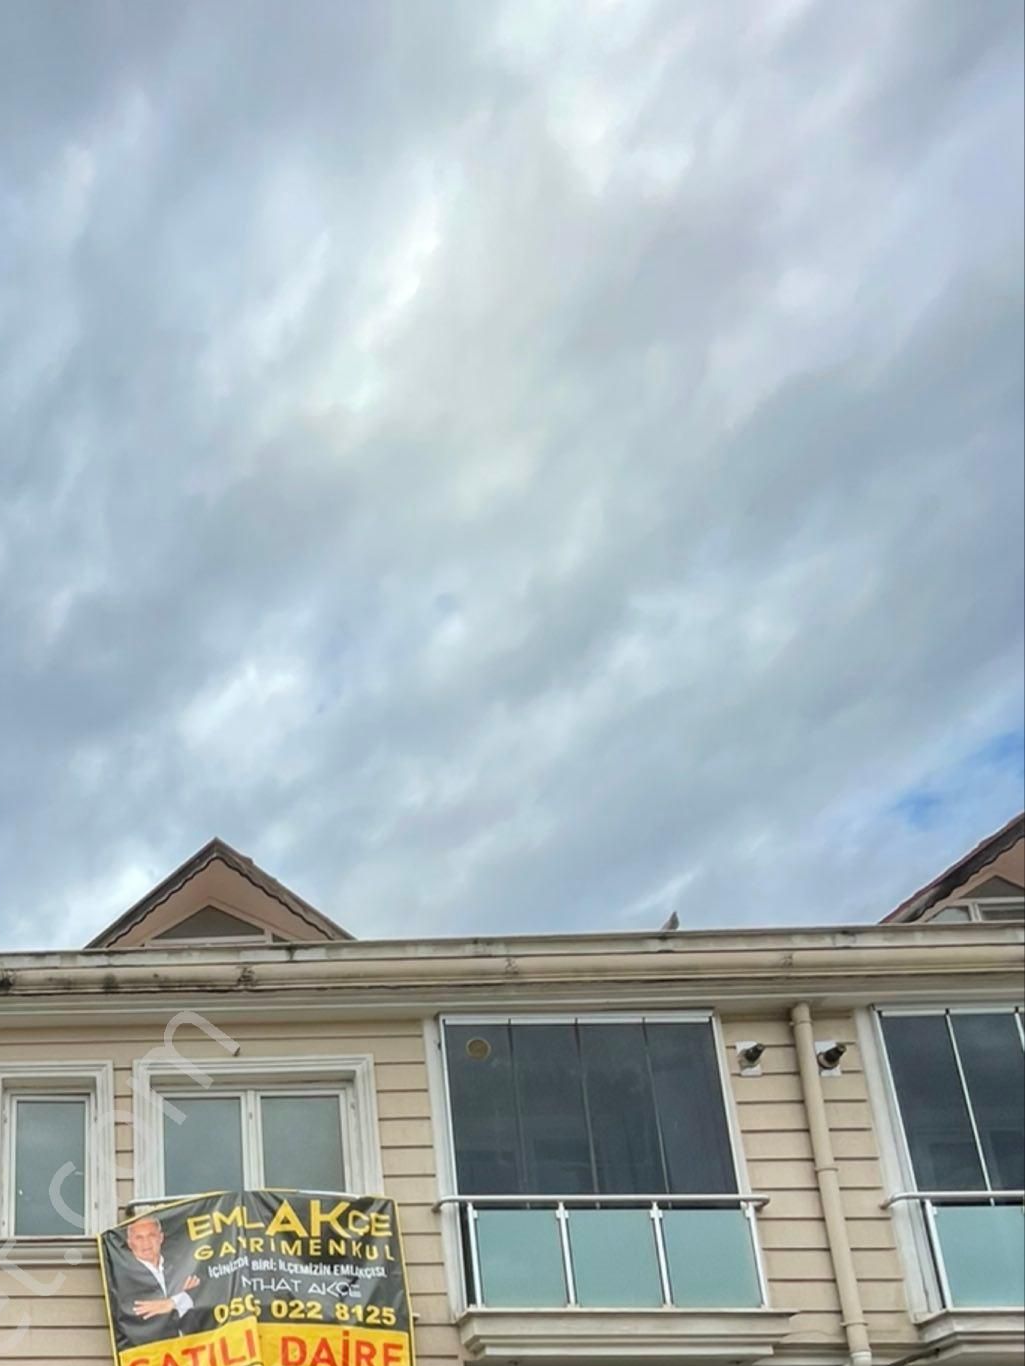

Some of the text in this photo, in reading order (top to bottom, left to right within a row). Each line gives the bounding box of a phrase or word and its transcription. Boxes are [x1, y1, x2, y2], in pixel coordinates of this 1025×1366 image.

[187, 1199, 393, 1241] EMLAKÇE
[270, 1299, 323, 1319] 022
[334, 1303, 396, 1325] 8125
